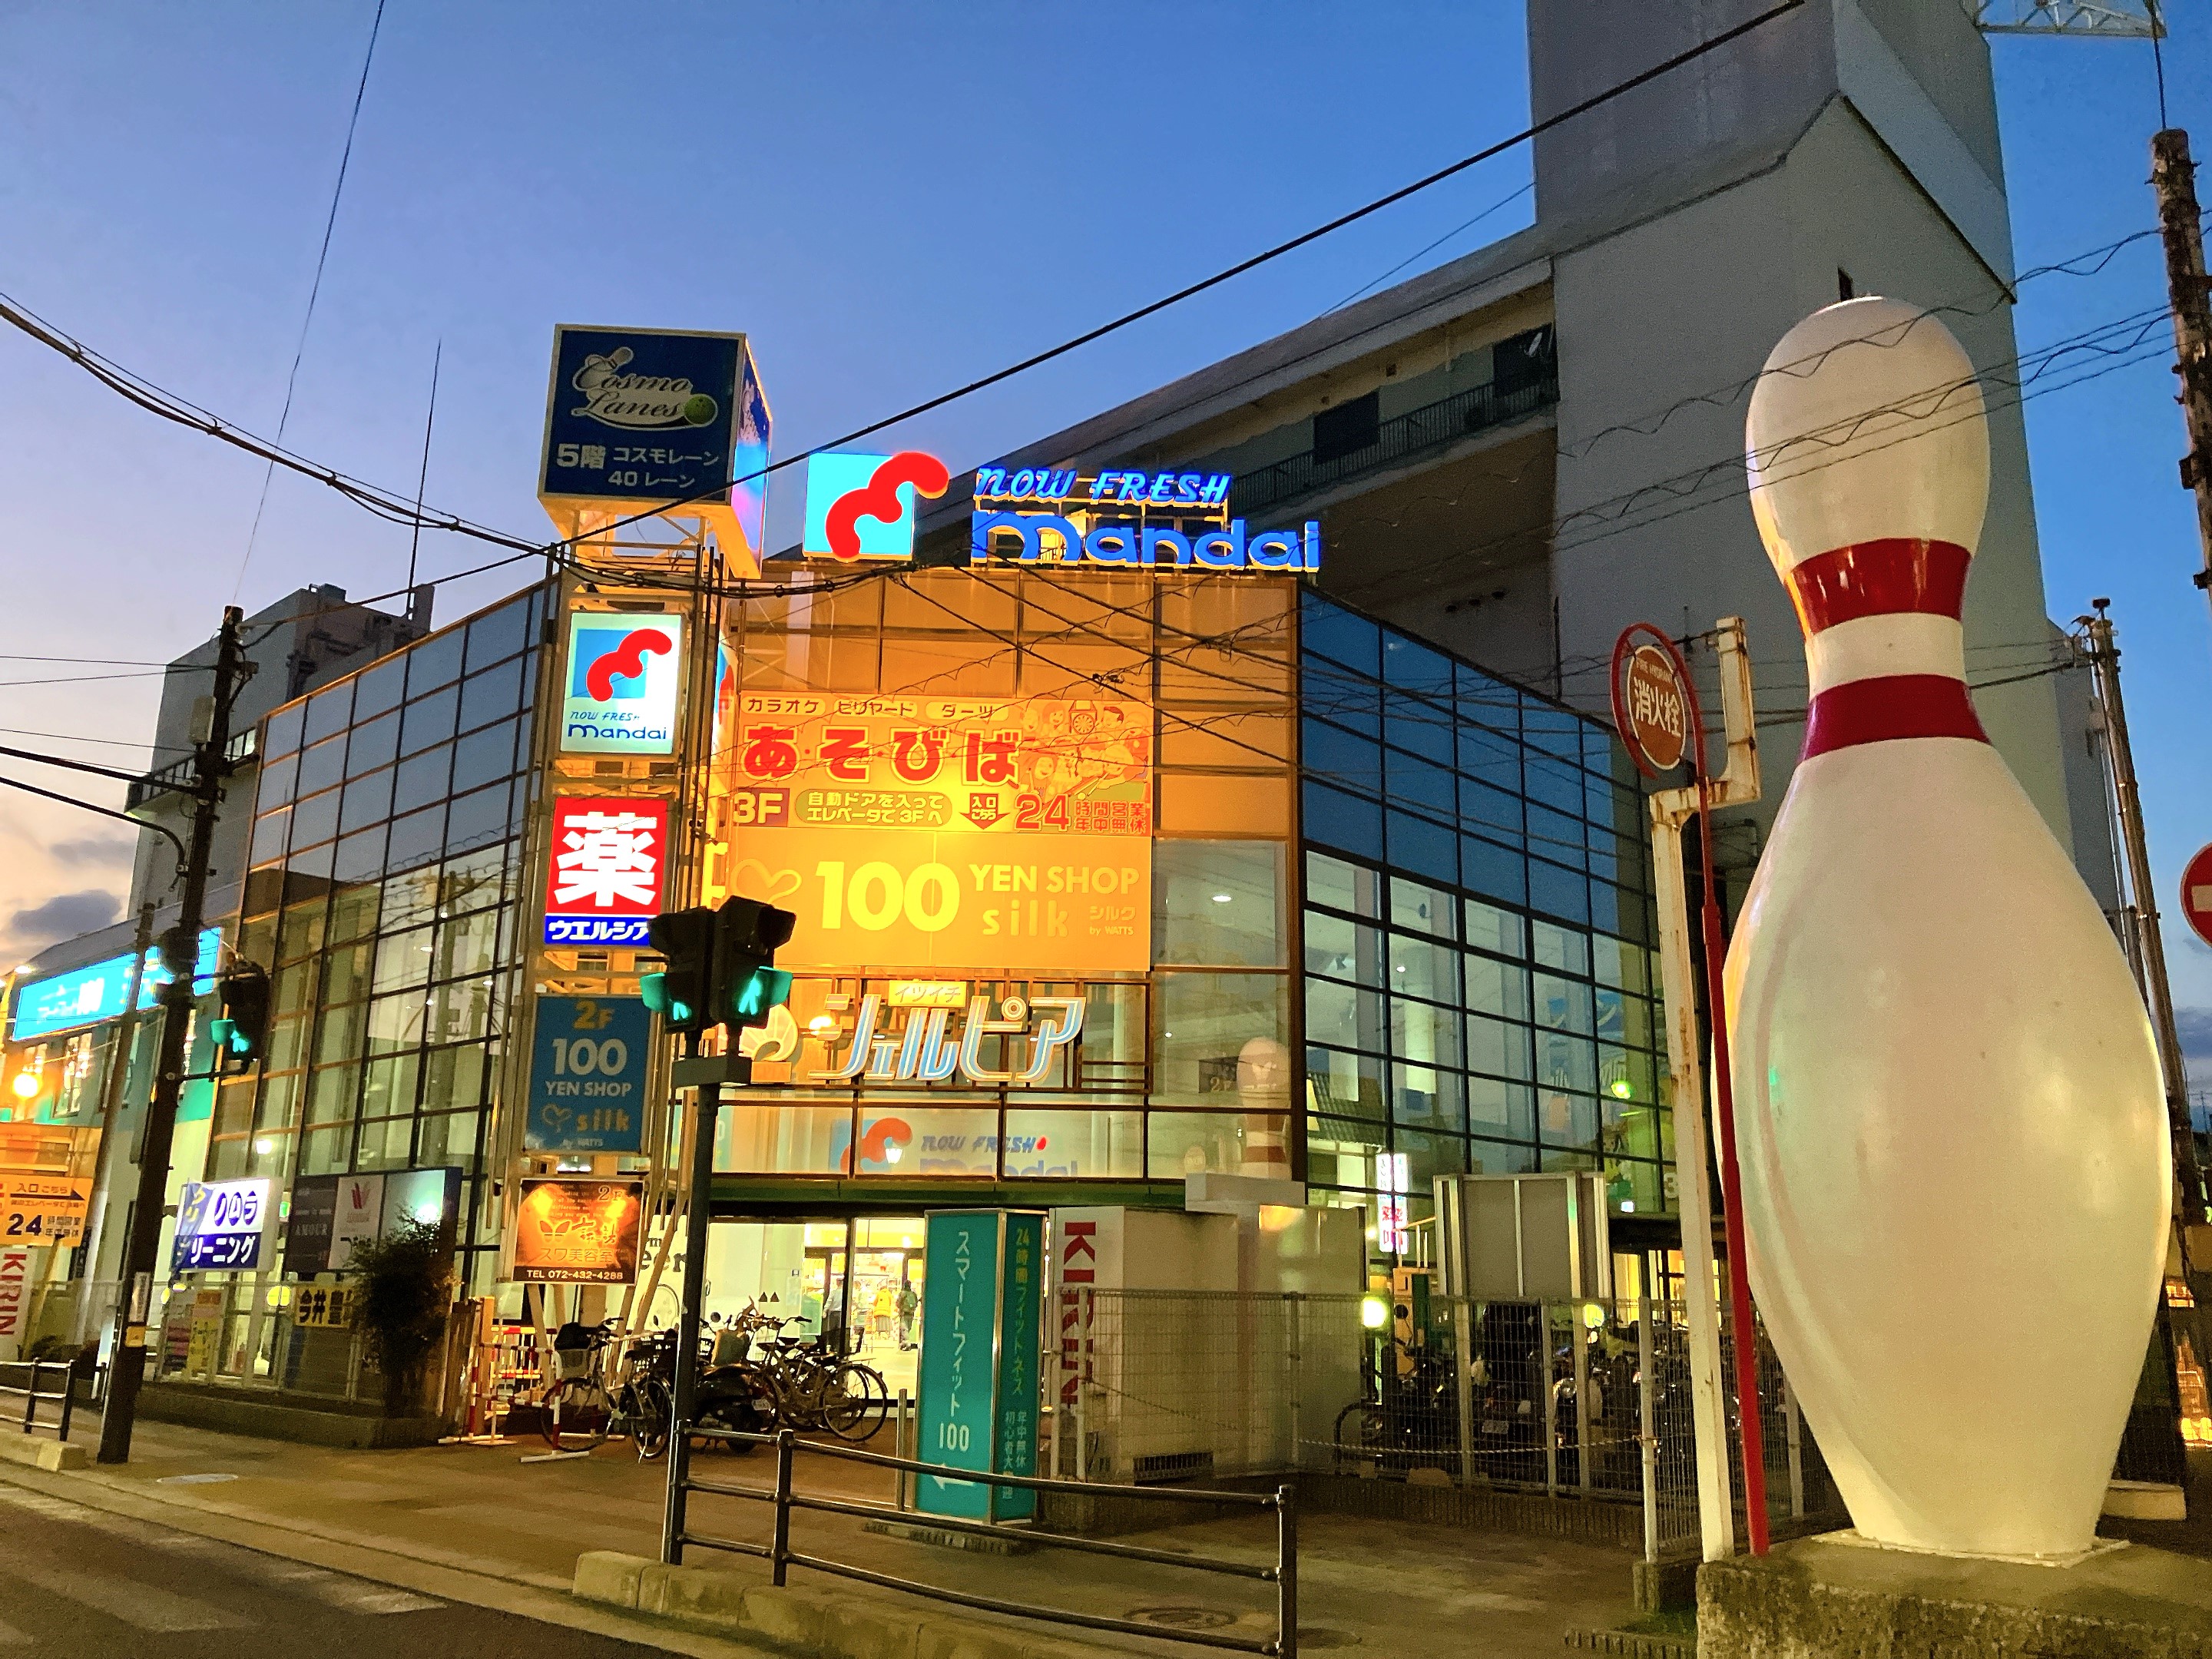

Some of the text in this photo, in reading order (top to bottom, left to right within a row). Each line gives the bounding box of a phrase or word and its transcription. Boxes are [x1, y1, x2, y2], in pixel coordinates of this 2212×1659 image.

[575, 354, 690, 392] Cosmo
[573, 389, 682, 419] Lanes
[556, 443, 720, 470] 5階 コスモレーン
[608, 471, 696, 489] 40 レーン
[1090, 469, 1232, 505] FRESH
[972, 510, 1320, 571] mandai
[747, 698, 997, 719] カラオケ ビリヤード ダーツ
[1634, 677, 1681, 737] 消火栓
[568, 724, 667, 740] mandai
[732, 793, 784, 824] 3F
[808, 791, 945, 809] 自動ドアを入って
[972, 796, 997, 808] 入口
[1015, 793, 1071, 832] 24
[1075, 800, 1146, 817] 時間営業
[971, 808, 997, 820] こちら
[1074, 817, 1147, 834] 年中無休
[554, 811, 657, 908] 薬
[815, 861, 1140, 932] 100 YEN SHOP
[982, 899, 1070, 937] silk
[1089, 906, 1136, 922] シルク
[548, 919, 649, 942] ウエルシア
[1089, 926, 1134, 936] by WATTS
[895, 986, 961, 1004] イツイチ
[573, 1000, 615, 1031] 2F
[808, 992, 1087, 1083] シェルピア
[552, 1038, 628, 1076] 100
[545, 1081, 632, 1098] YEN SHOP
[576, 1106, 631, 1133] silk
[598, 1184, 625, 1201] 2F
[214, 1190, 258, 1227] ノムラ
[6, 1213, 42, 1236] 24
[190, 1235, 257, 1264] リーニング
[539, 1247, 615, 1263] スワ美容室
[527, 1270, 624, 1280] TEL 072-432-4288
[949, 1231, 972, 1418] スマートフィット
[938, 1422, 971, 1452] 100
[1002, 1409, 1018, 1501] 初心者大迎
